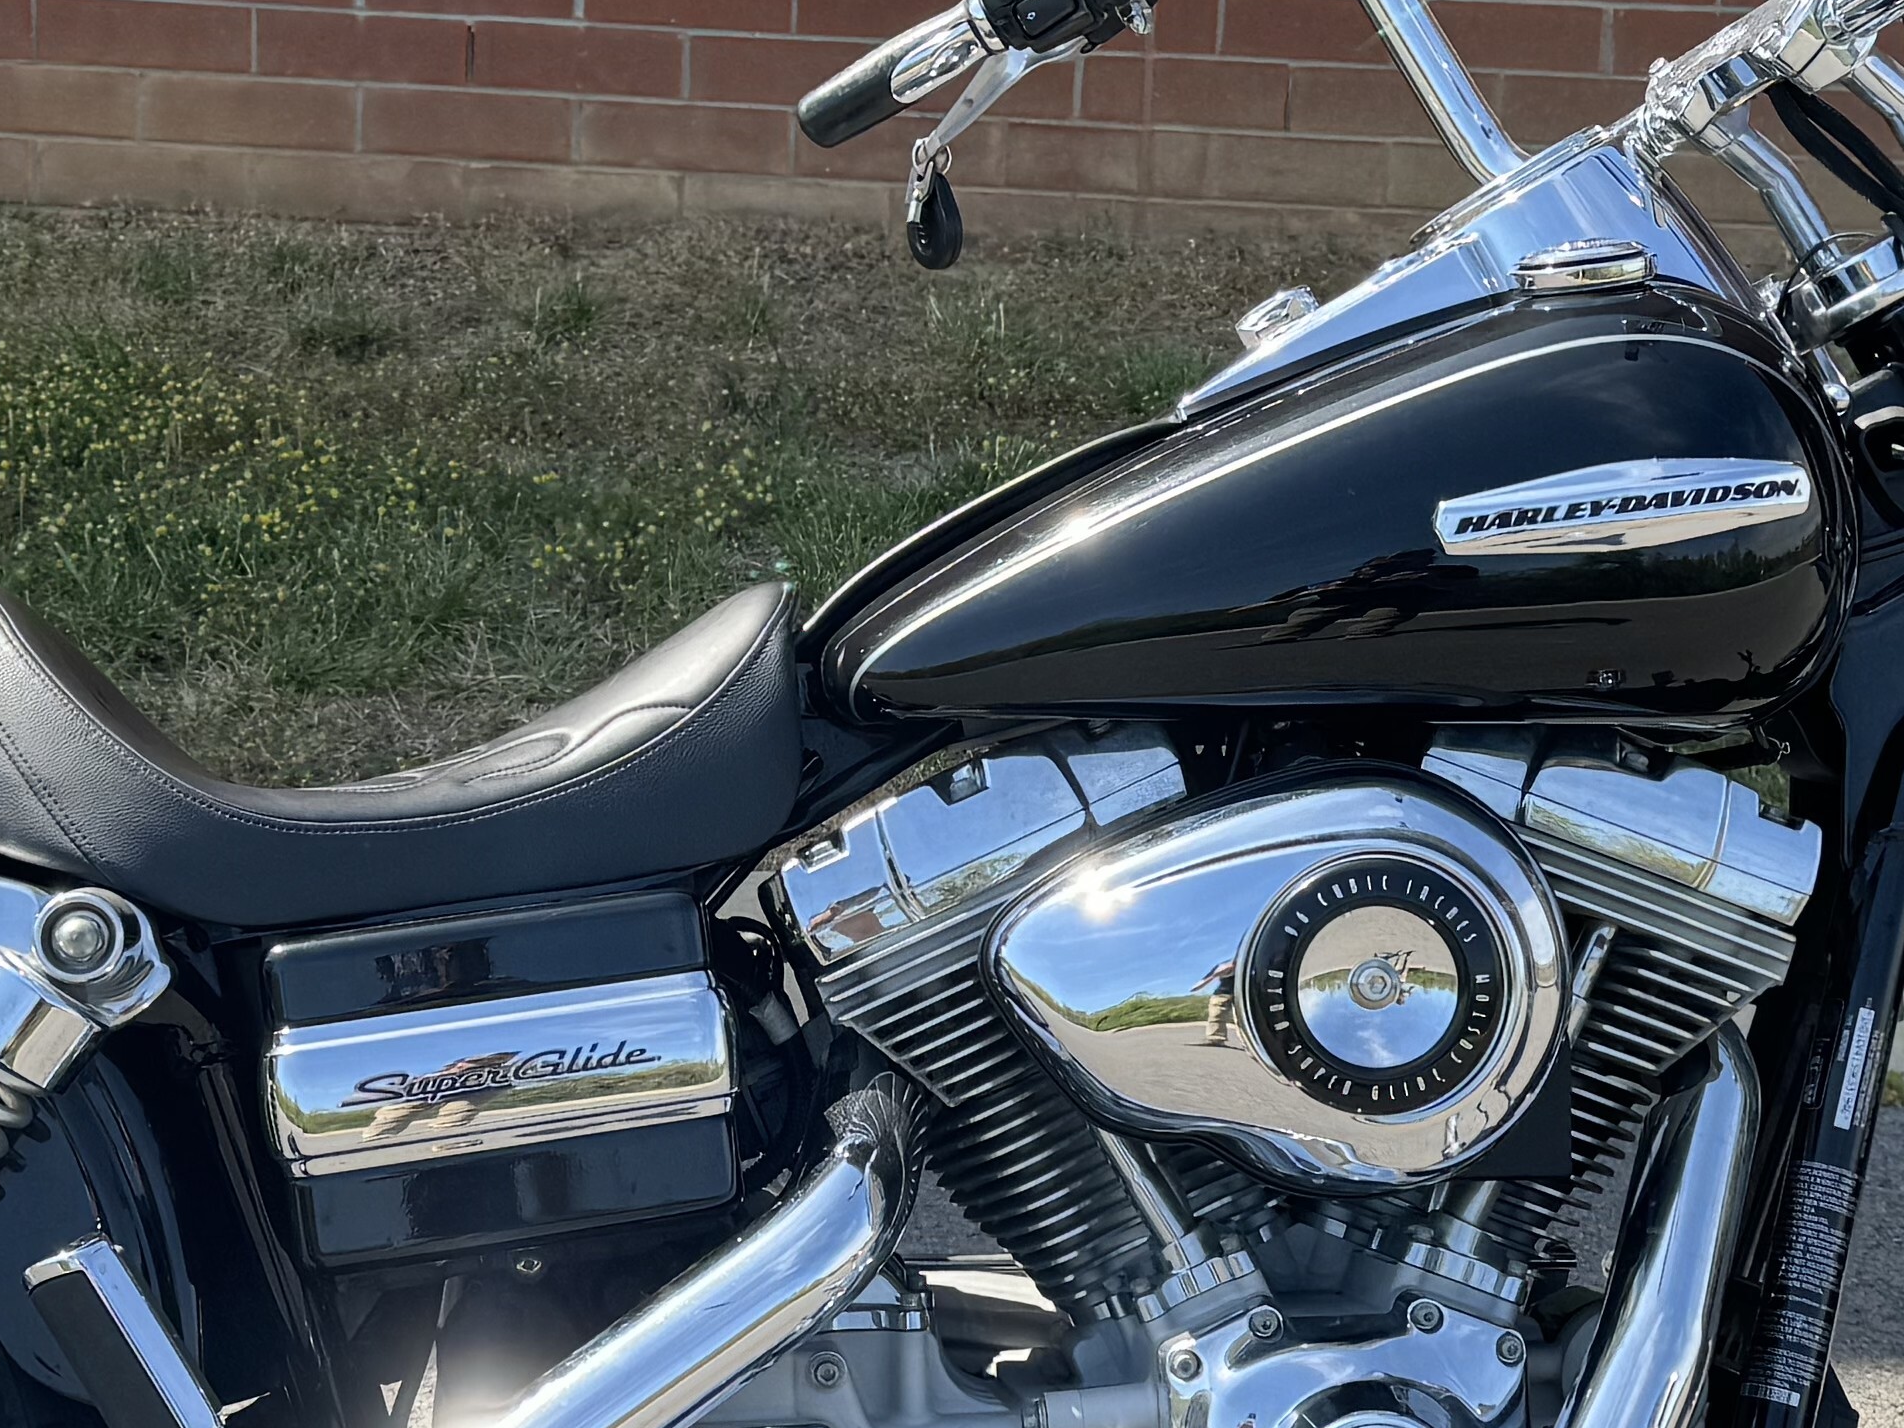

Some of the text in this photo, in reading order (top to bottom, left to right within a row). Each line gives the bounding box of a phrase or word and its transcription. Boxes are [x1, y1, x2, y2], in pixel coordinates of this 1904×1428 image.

[1454, 478, 1799, 534] HARLEY-DAVIDSON
[1317, 875, 1388, 906] CUBIC
[1406, 879, 1477, 943] INCHES
